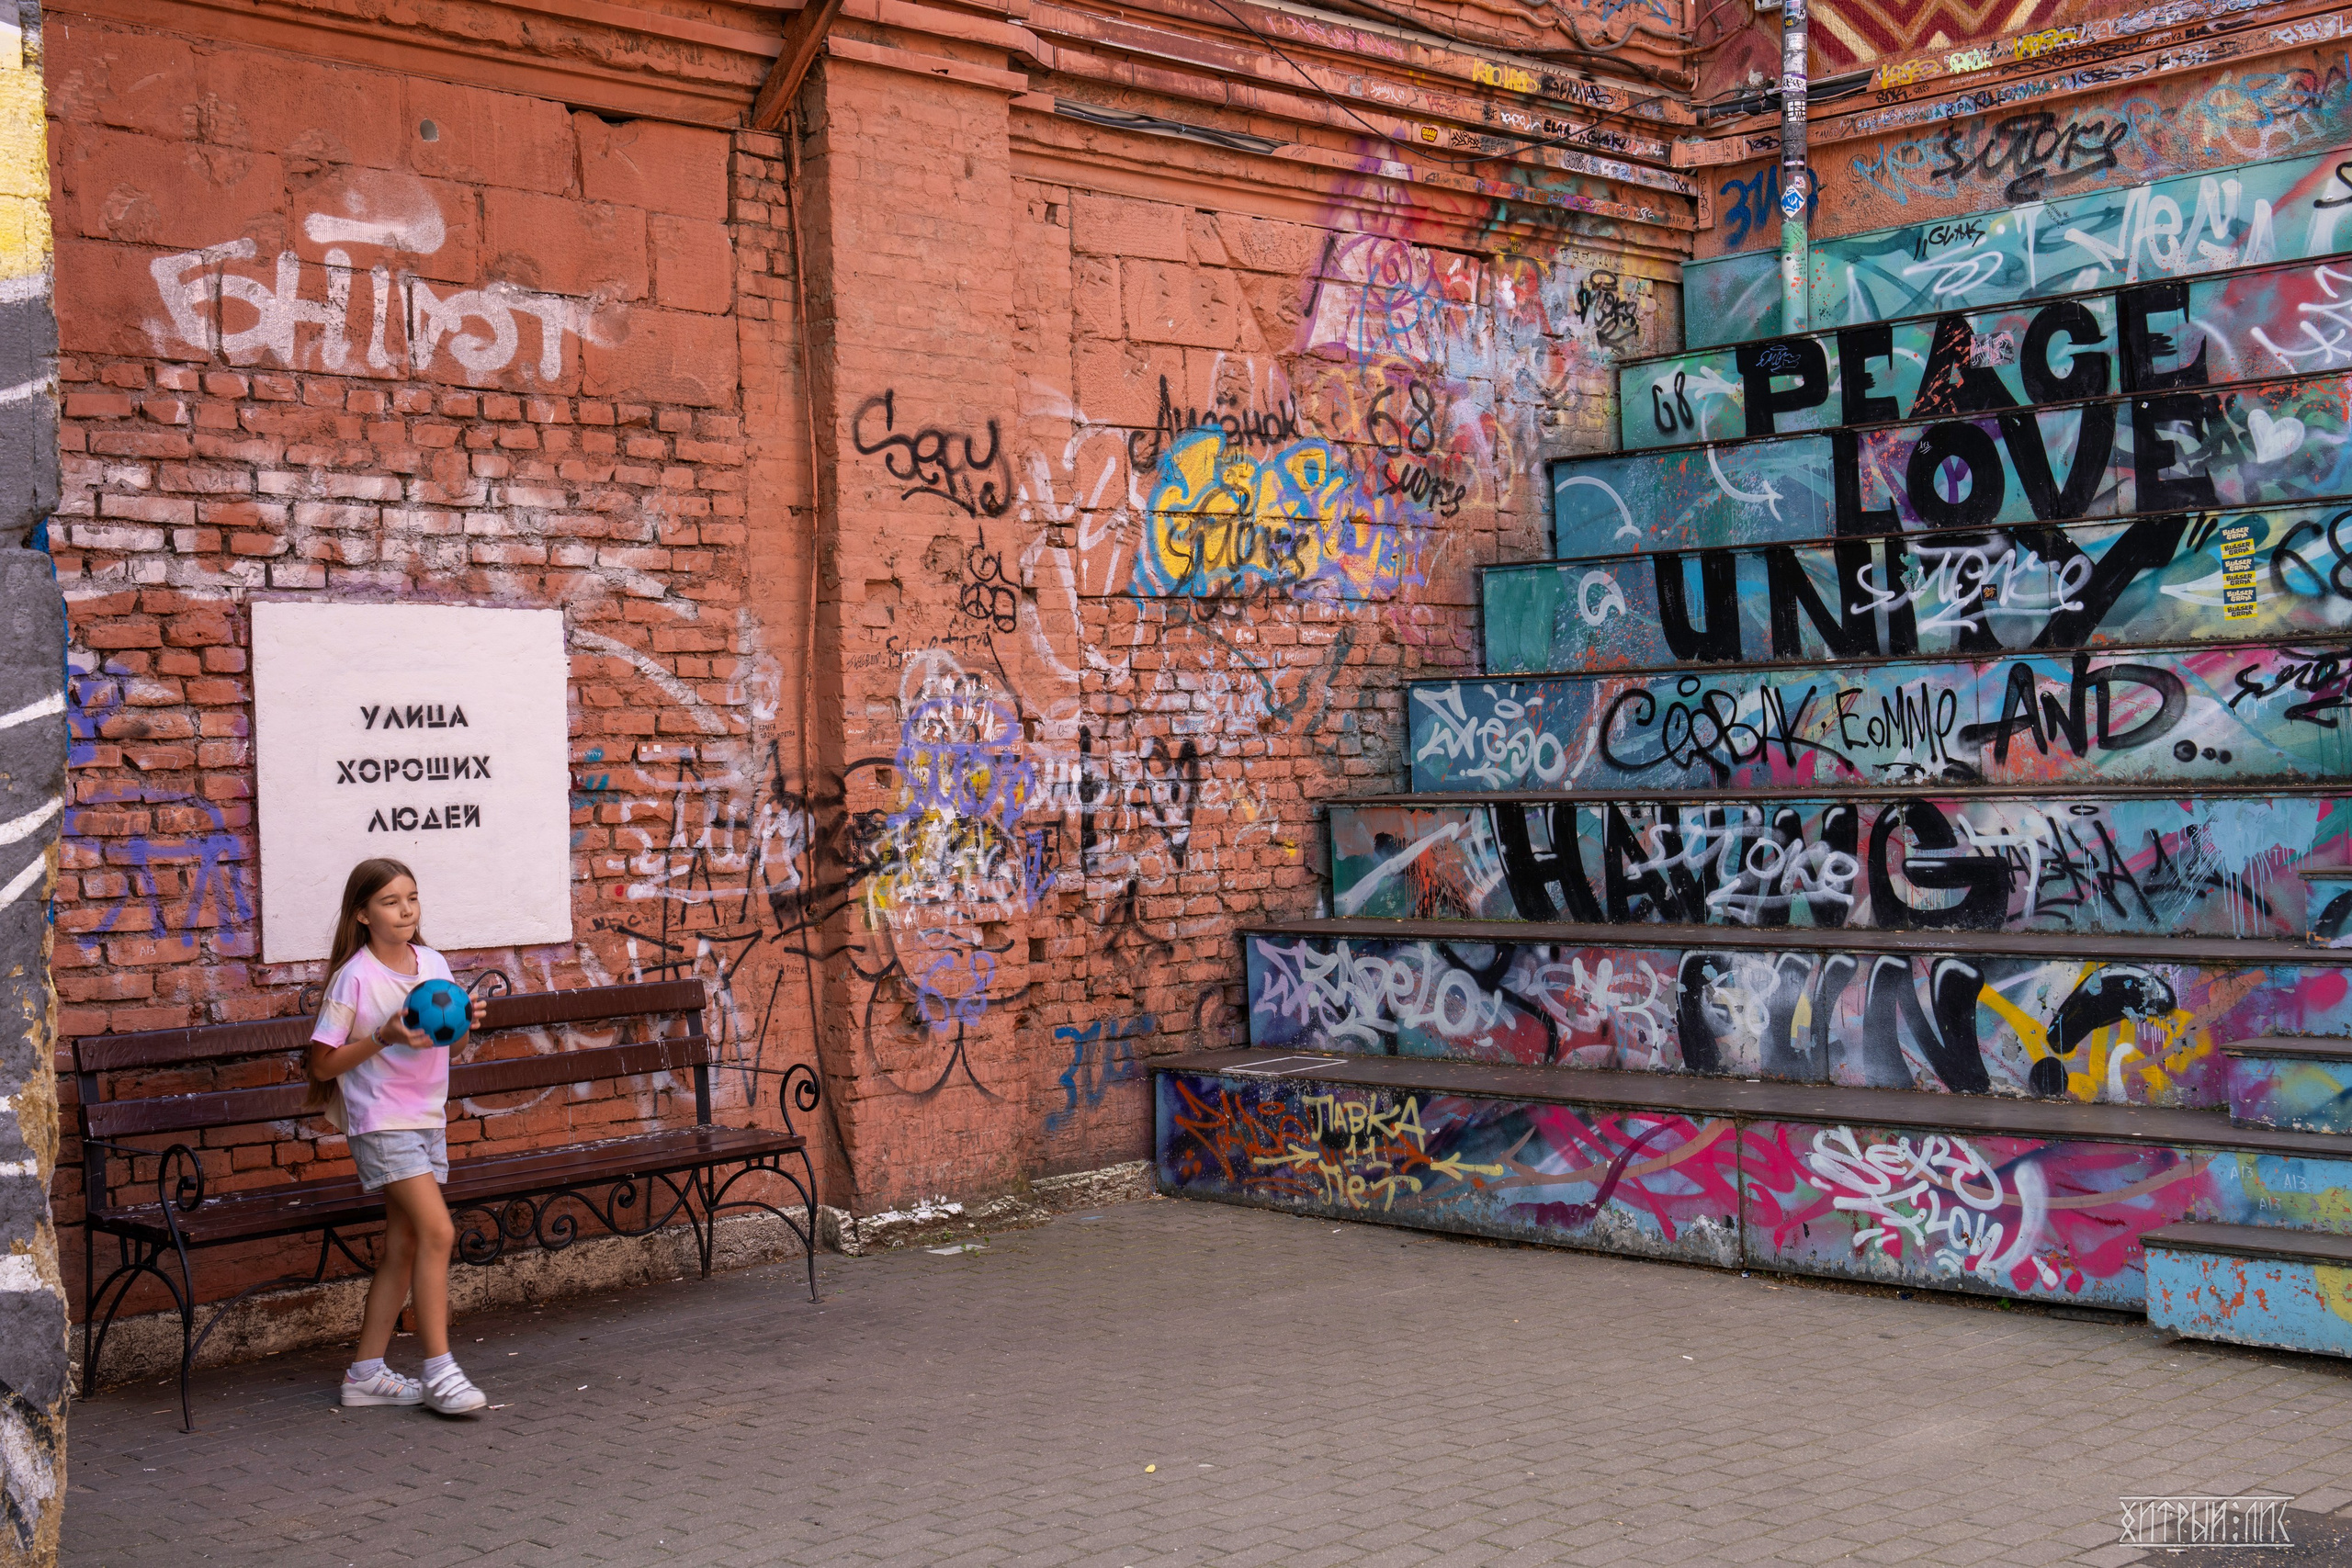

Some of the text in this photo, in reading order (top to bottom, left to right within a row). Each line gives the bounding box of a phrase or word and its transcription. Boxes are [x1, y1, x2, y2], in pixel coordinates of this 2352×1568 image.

[1736, 282, 2209, 435] PEACE
[1836, 393, 2218, 536] LOVE
[360, 705, 469, 729] УЛИЦА
[336, 756, 492, 784] ХОРОШИХ
[368, 805, 481, 832] ЛЮДЕЙ
[2230, 1166, 2254, 1179] A13
[2284, 1173, 2307, 1190] A13
